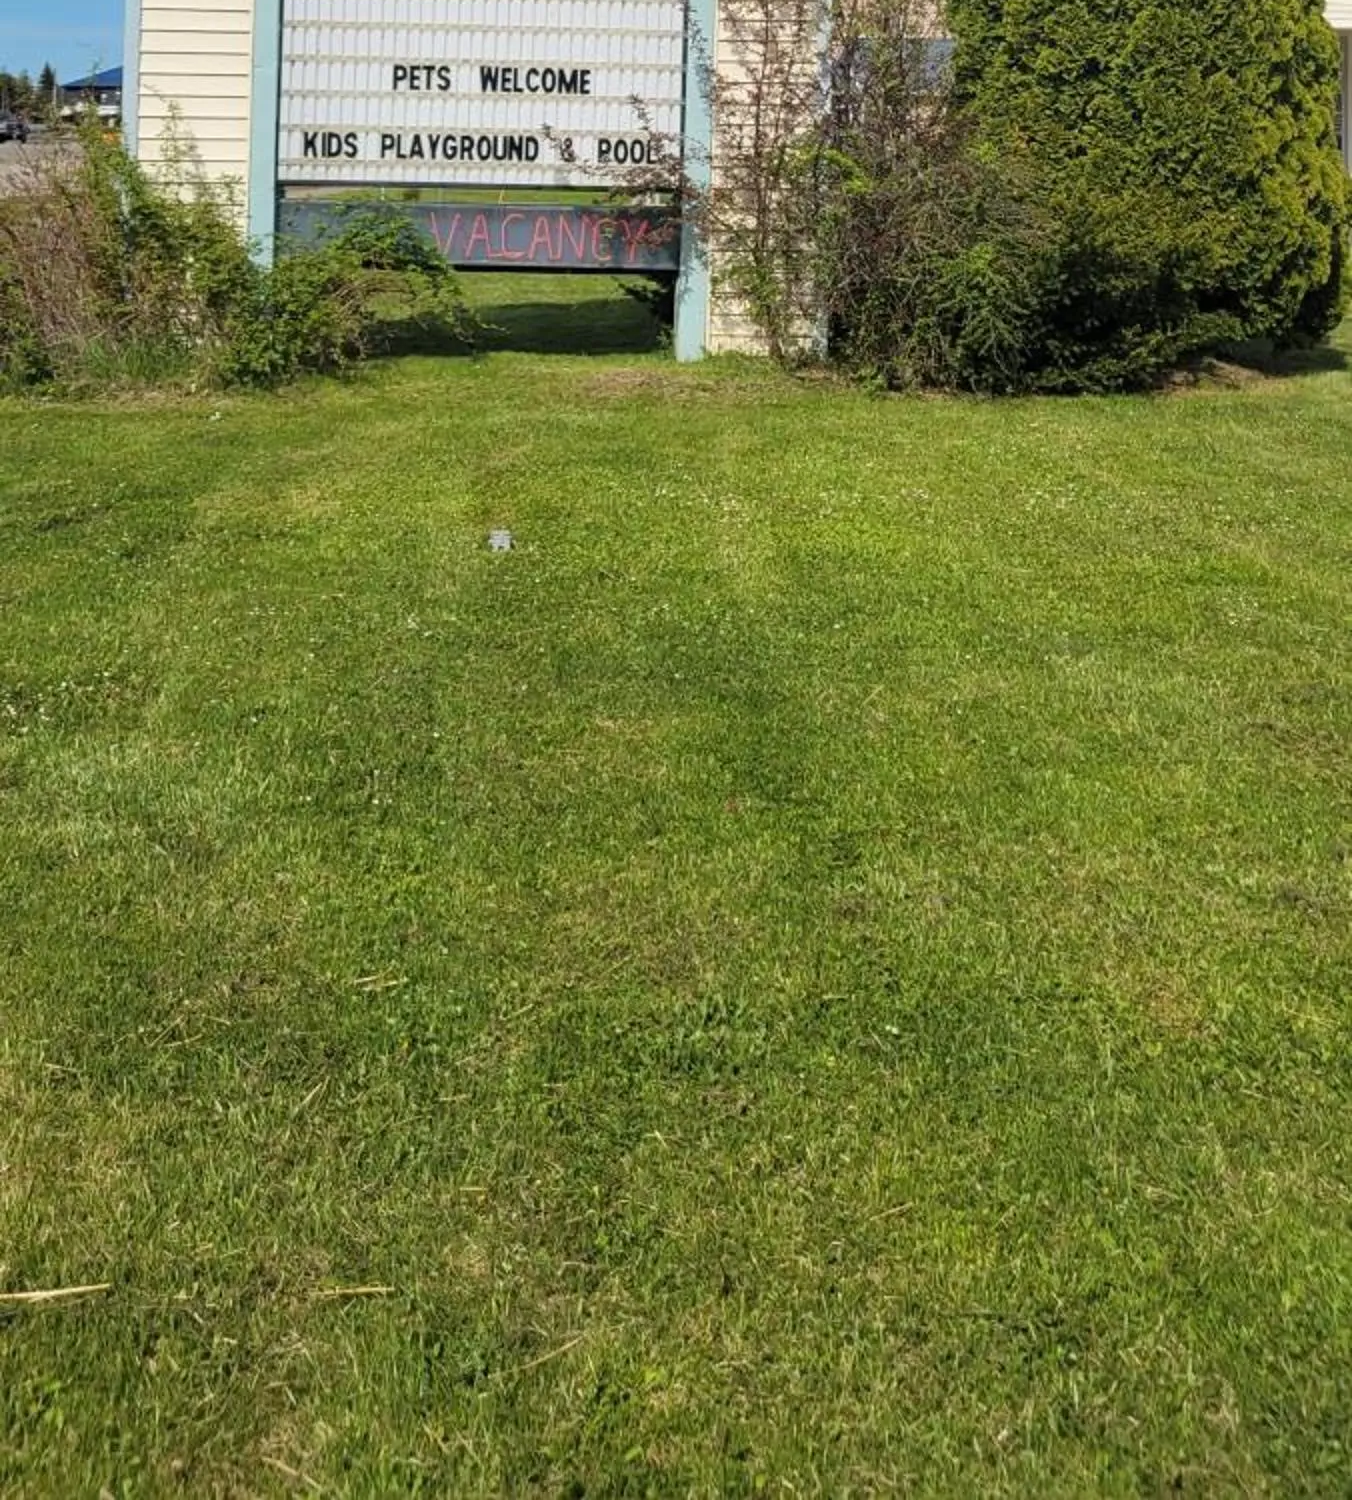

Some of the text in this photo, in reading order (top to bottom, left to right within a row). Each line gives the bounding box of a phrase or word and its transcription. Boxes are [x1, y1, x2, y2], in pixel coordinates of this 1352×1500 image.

[392, 65, 591, 95] PETS WELCOME
[303, 132, 358, 158] KIDS
[380, 133, 539, 162] PLAYGROUND
[598, 138, 659, 165] POOL
[429, 211, 650, 263] VACANCY
